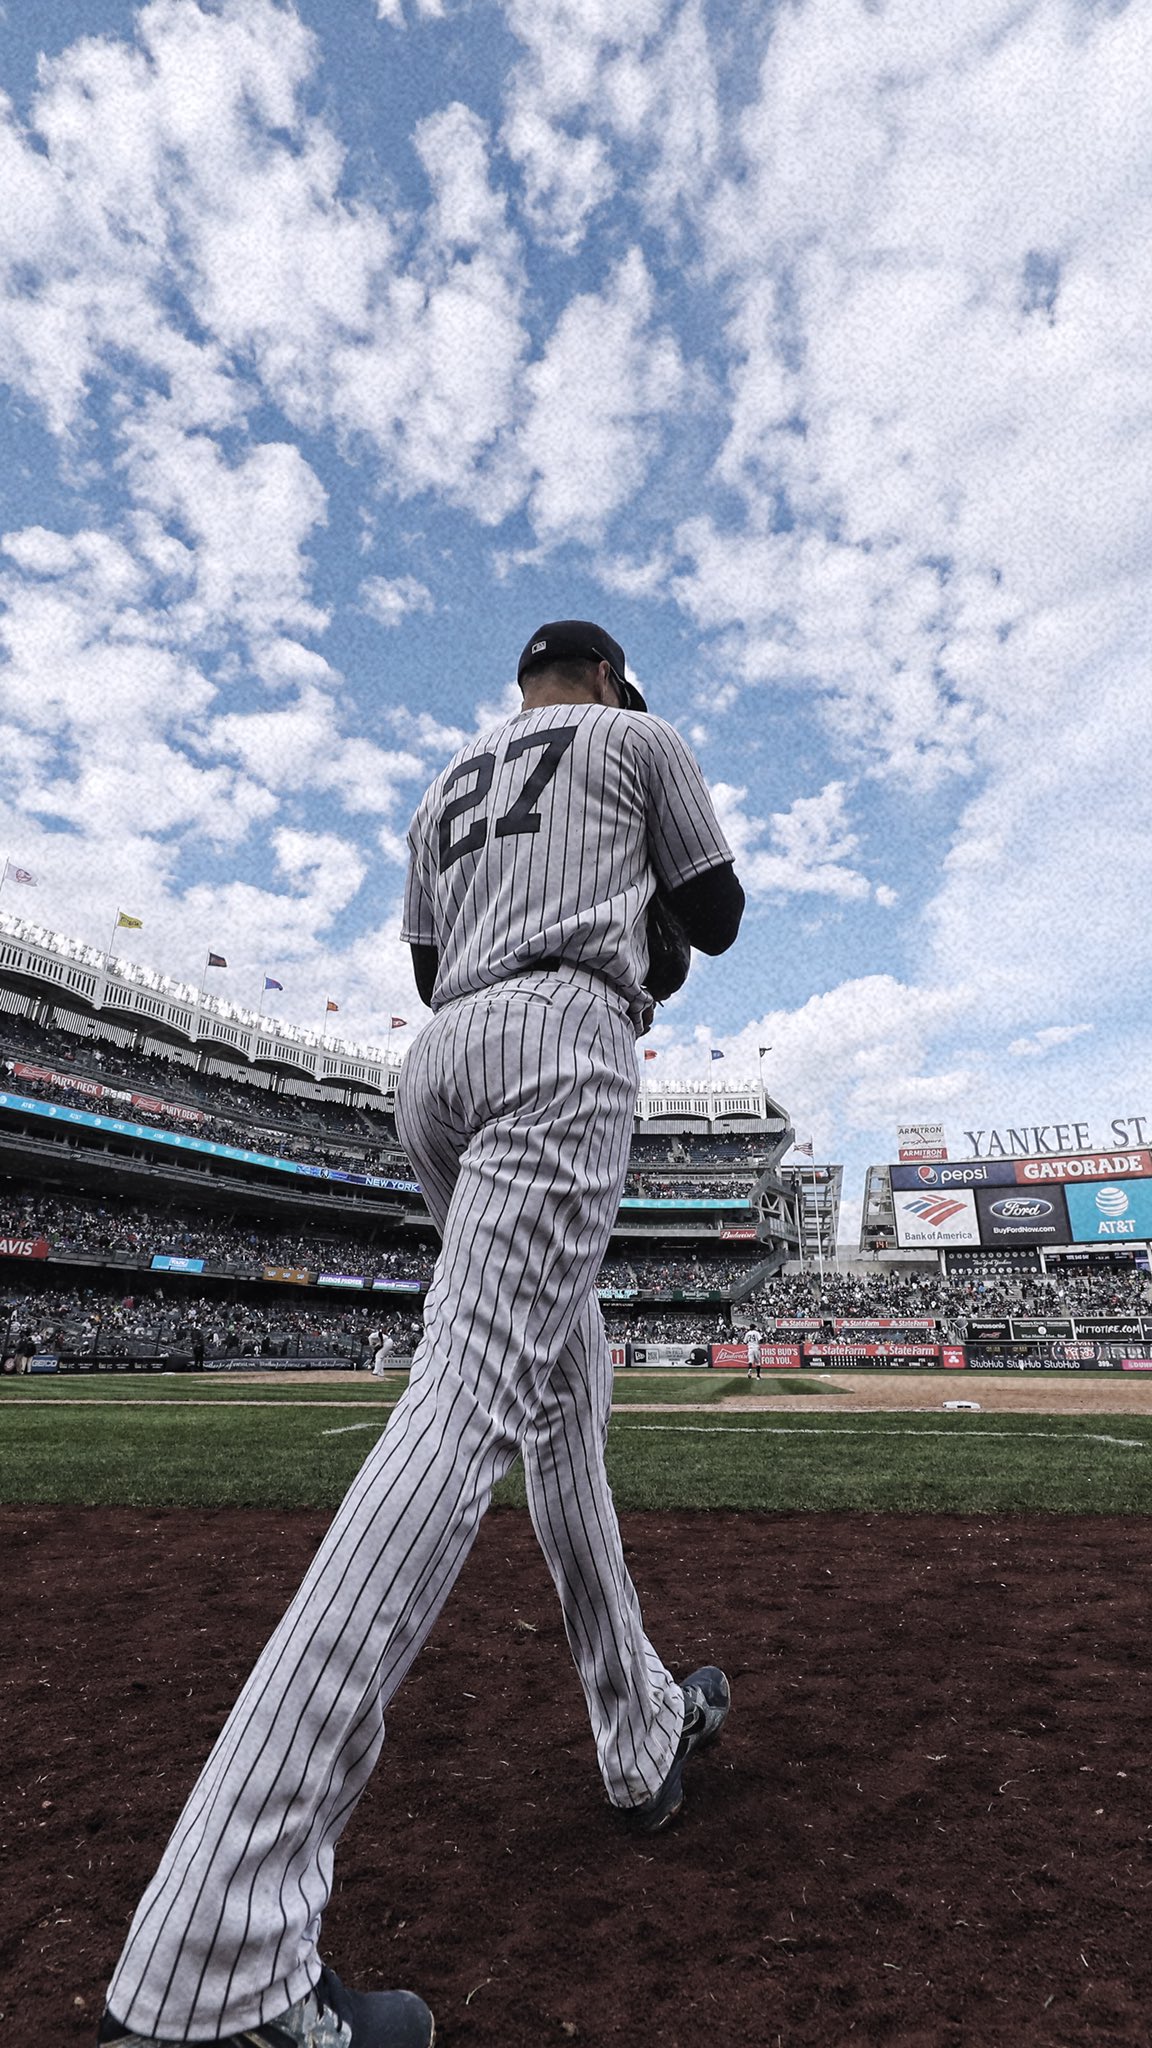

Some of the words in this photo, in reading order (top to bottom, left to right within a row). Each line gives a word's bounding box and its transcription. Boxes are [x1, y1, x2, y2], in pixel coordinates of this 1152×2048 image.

[439, 725, 578, 875] 27
[77, 1082, 98, 1095] DECK
[161, 1104, 182, 1117] PARTY
[182, 1109, 199, 1120] DECK
[898, 1126, 942, 1134] ARMITRON
[963, 1122, 1093, 1158] YANKEE
[903, 1149, 942, 1157] ARMITRON
[1023, 1155, 1143, 1179] GATORADE
[941, 1166, 988, 1184] pepsi
[365, 1177, 390, 1188] NEW
[391, 1180, 420, 1192] YORK
[1002, 1200, 1040, 1216] Ford
[993, 1226, 1056, 1235] BuyFordNow.com
[1098, 1219, 1136, 1234] AT&T
[904, 1232, 927, 1241] Bank
[927, 1231, 936, 1240] of
[936, 1231, 973, 1240] America
[0, 1239, 34, 1256] AVIS
[1075, 1323, 1141, 1334] NITTOTIRE.COM
[761, 1347, 776, 1356] THIS
[777, 1347, 798, 1356] BUD'S
[32, 1359, 58, 1367] GEICO
[761, 1356, 775, 1365] FOR
[775, 1356, 792, 1365] YOU.
[970, 1360, 1004, 1369] StubHub
[1043, 1360, 1081, 1369] StubHub
